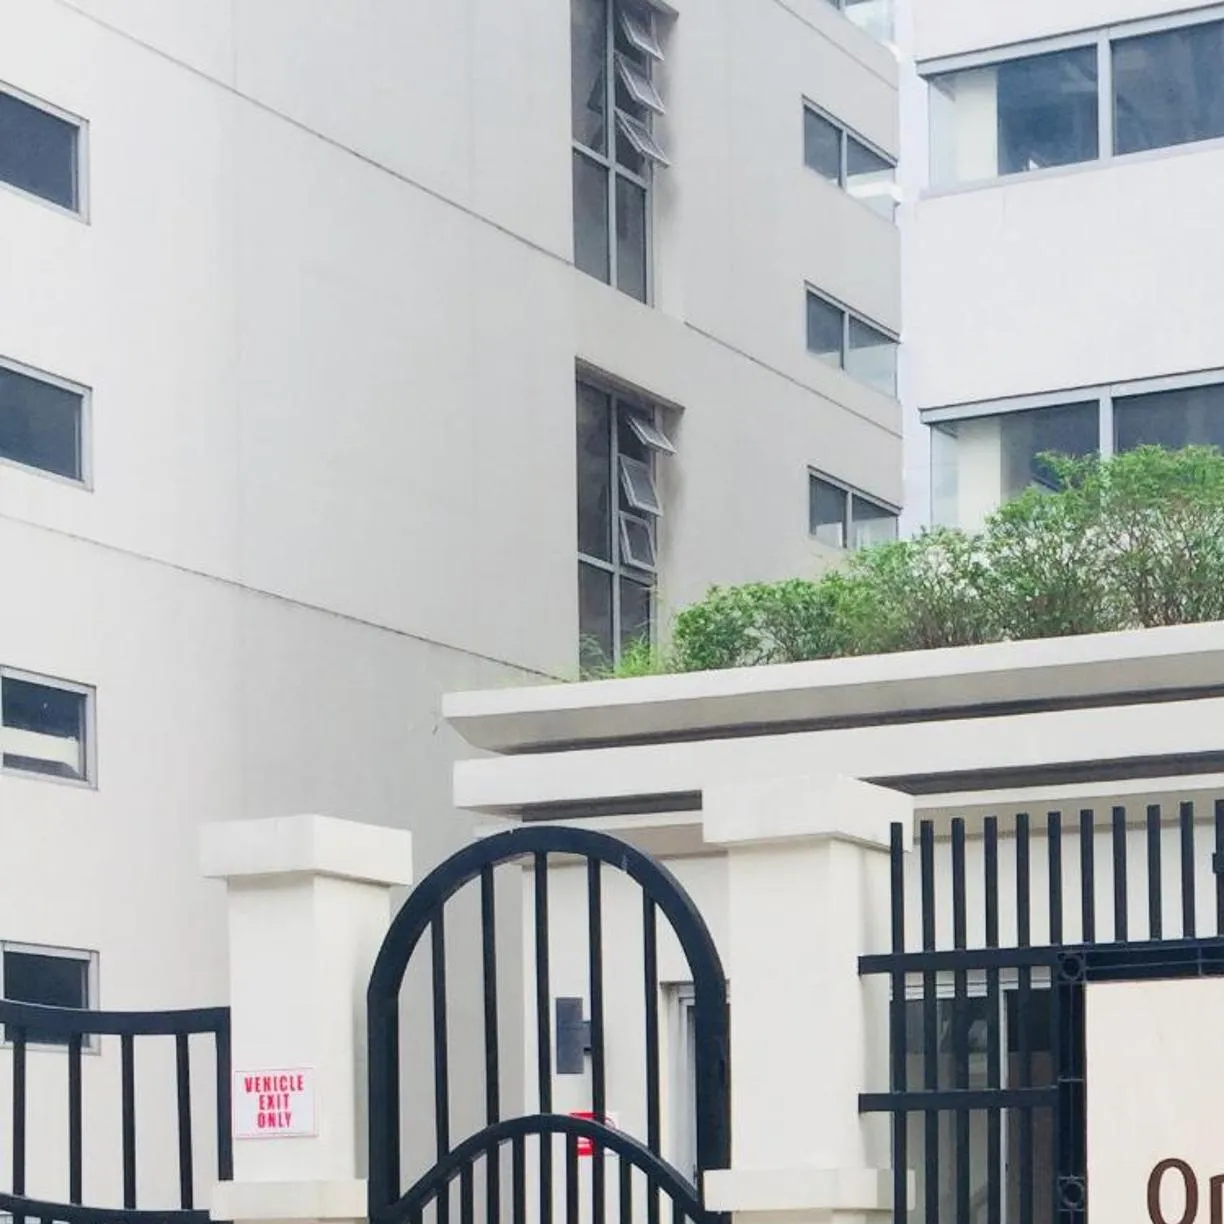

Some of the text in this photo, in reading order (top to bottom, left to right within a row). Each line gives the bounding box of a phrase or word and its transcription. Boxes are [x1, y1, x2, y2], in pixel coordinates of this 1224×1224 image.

[244, 1075, 304, 1092] VEHICLE
[259, 1093, 289, 1110] EXIT
[257, 1112, 291, 1128] ONLY
